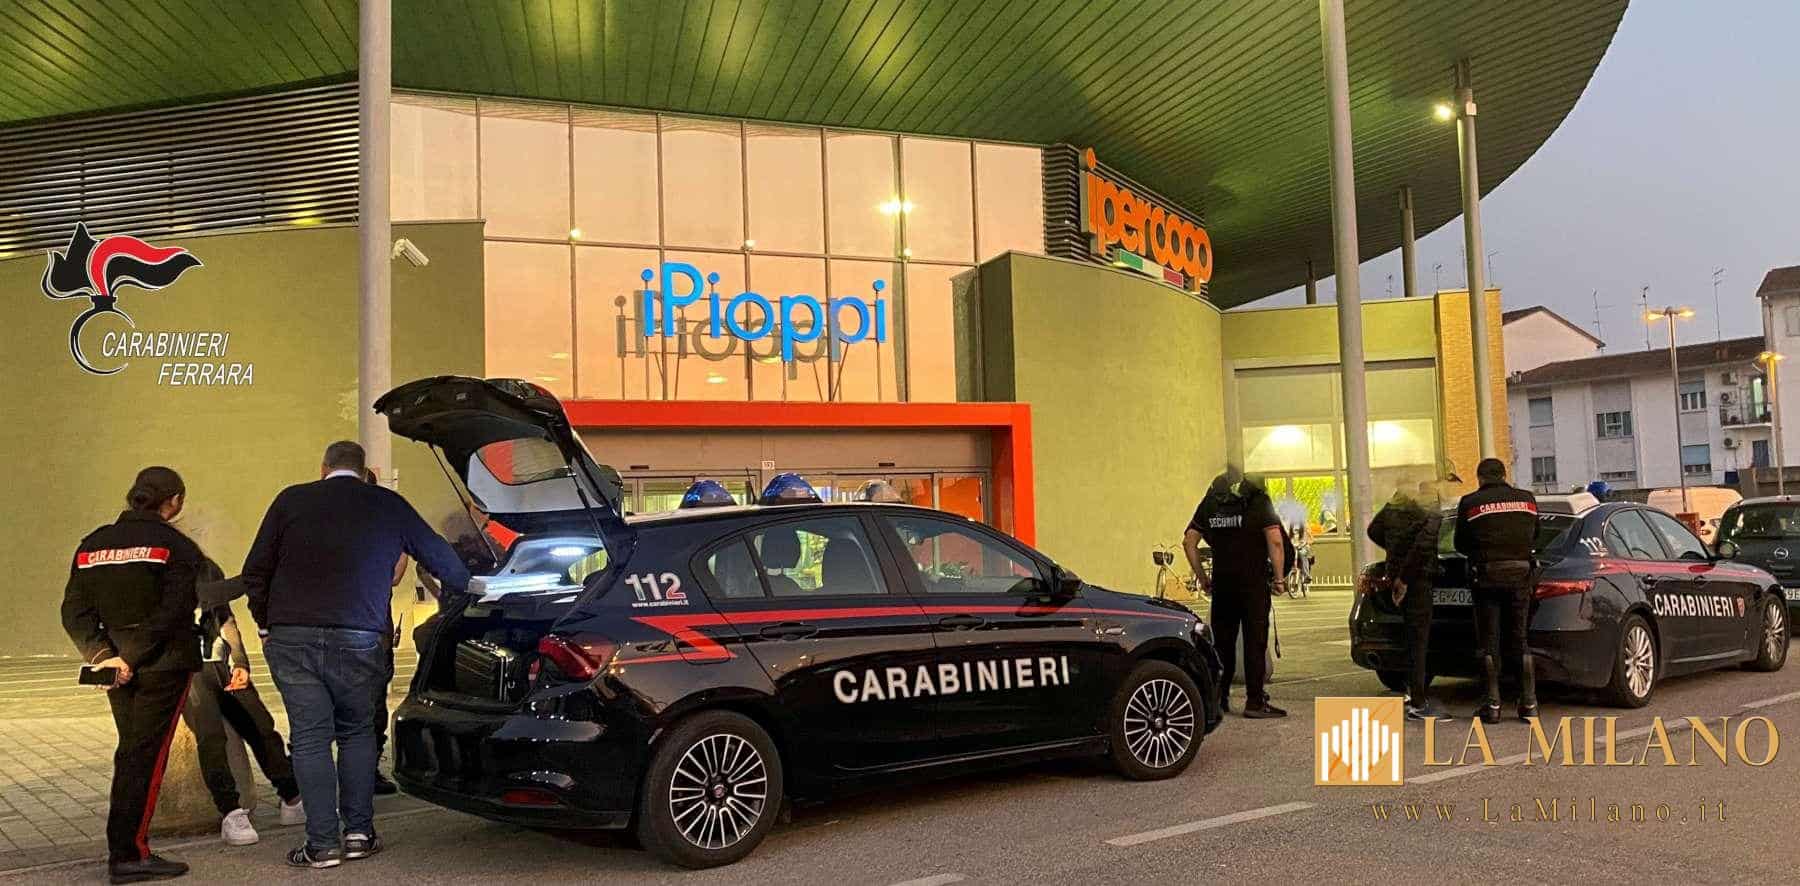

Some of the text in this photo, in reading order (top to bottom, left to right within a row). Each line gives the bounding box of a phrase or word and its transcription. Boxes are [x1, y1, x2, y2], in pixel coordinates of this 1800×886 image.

[1080, 147, 1214, 294] ipercoop
[641, 262, 887, 363] iPioppi
[1479, 502, 1529, 513] CARABINIERI
[87, 546, 153, 565] CARABINIERI
[1579, 536, 1609, 552] 112
[624, 572, 687, 601] 112
[1654, 593, 1735, 617] CARABINIERI
[833, 655, 1071, 704] CARABINIERI
